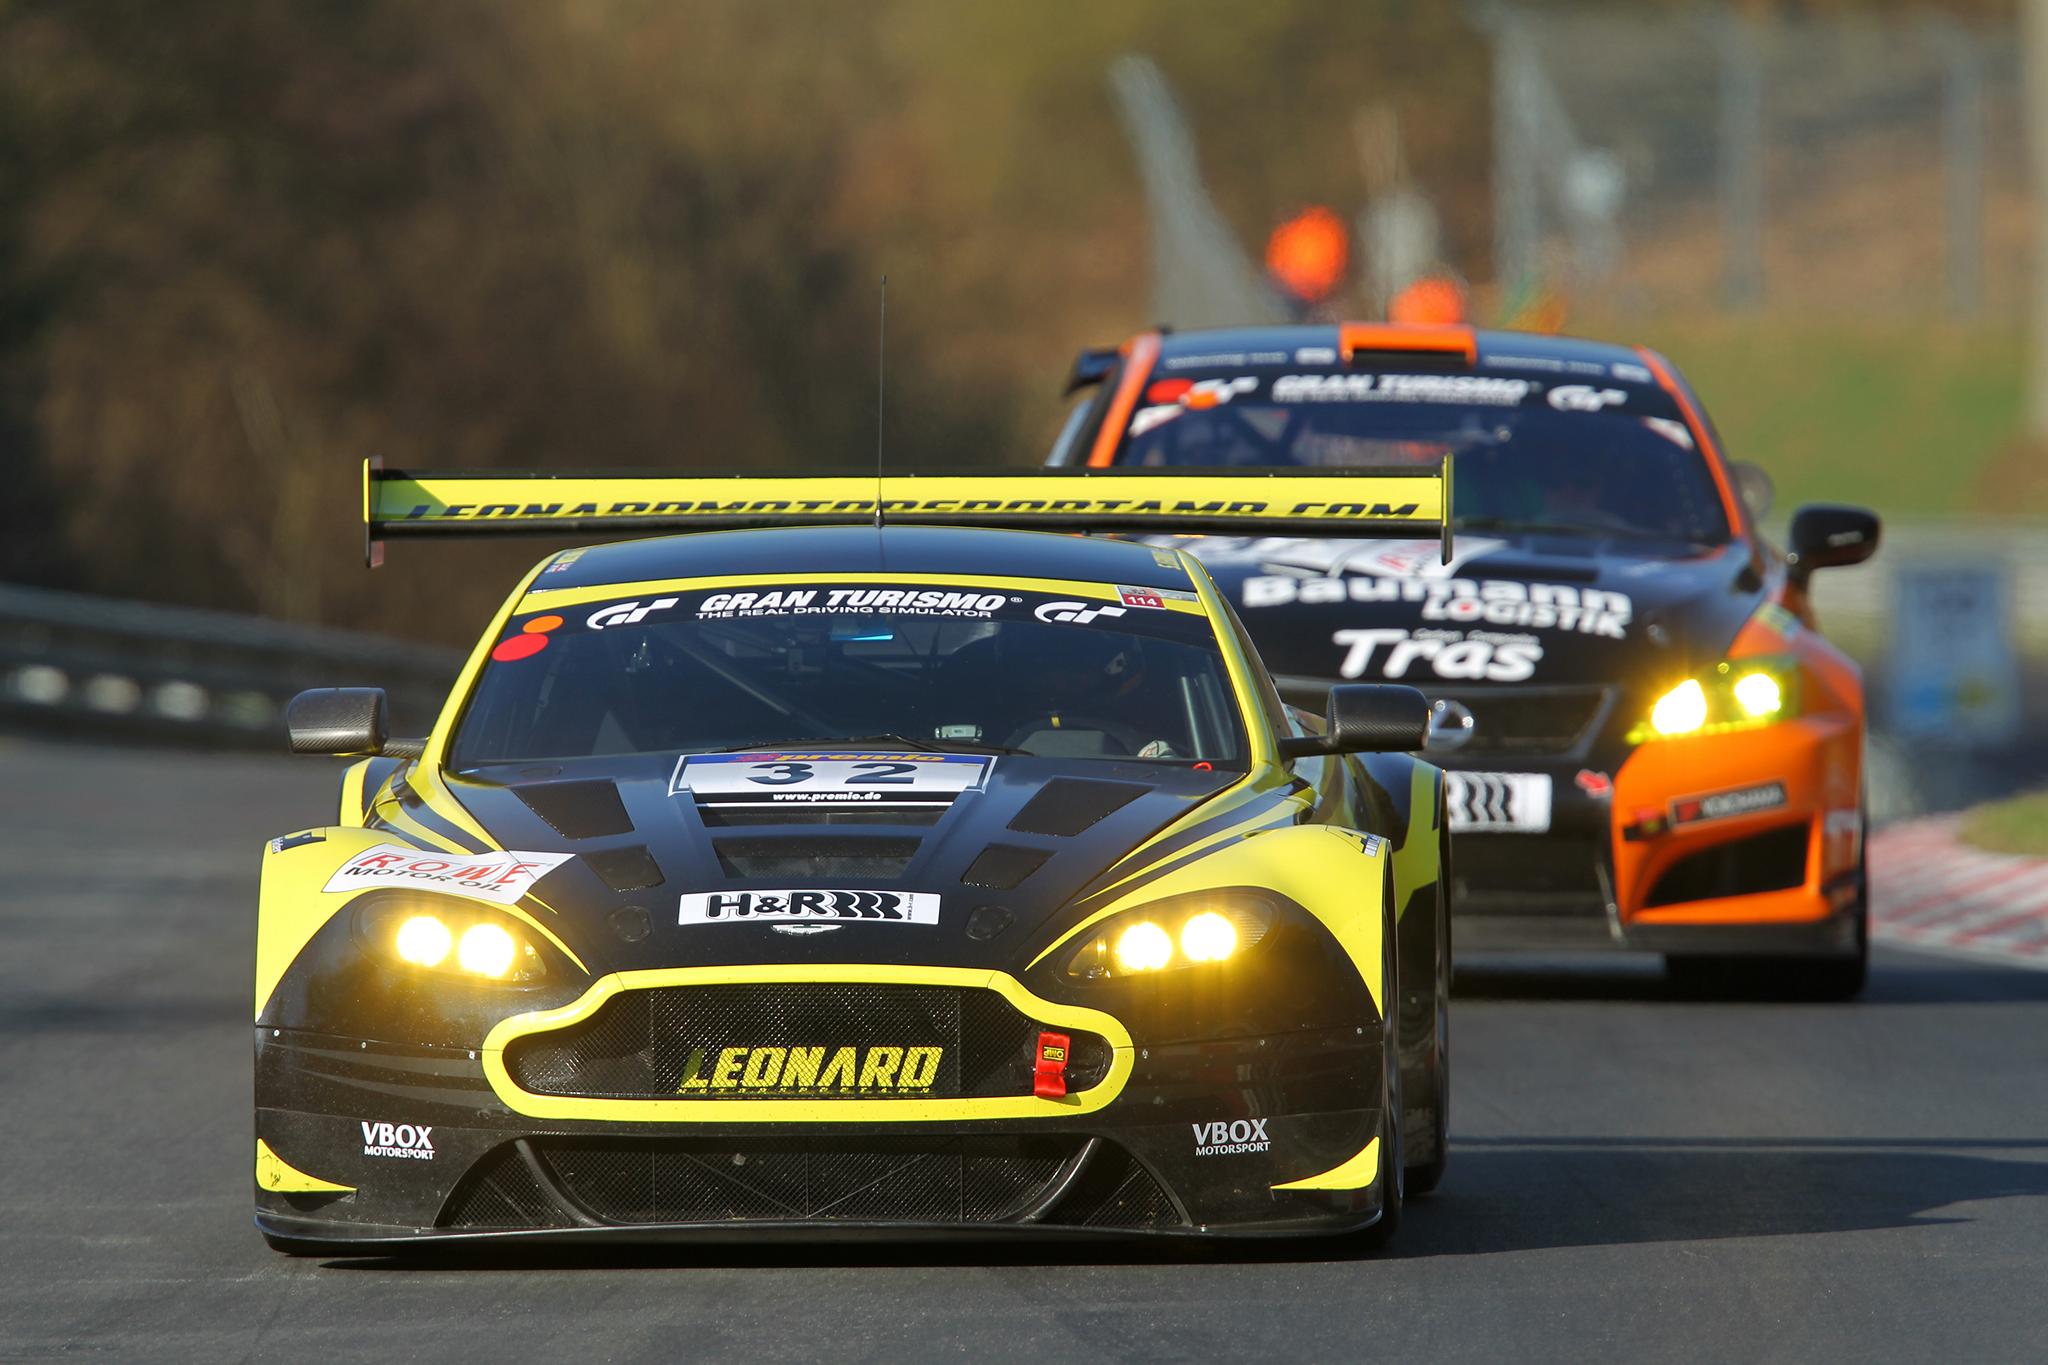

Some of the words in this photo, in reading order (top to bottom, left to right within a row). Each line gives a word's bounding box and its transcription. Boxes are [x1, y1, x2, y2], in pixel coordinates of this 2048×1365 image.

[700, 590, 818, 612] GRAN
[821, 589, 1007, 612] TURISMO
[1127, 595, 1158, 607] 114
[1242, 574, 1632, 620] Baumann
[696, 611, 734, 620] THE
[738, 608, 788, 618] REAL
[793, 606, 874, 615] DRIVING
[878, 605, 992, 619] SIMULATOR
[1421, 599, 1626, 640] LOGISTIK
[1332, 628, 1545, 682] Tras
[344, 866, 454, 882] MOTOR
[458, 879, 503, 893] OIL
[359, 854, 539, 885] ROWE
[681, 1046, 945, 1088] LEONARD
[361, 1121, 434, 1149] VBOX
[1191, 1118, 1269, 1146] VBOX
[364, 1145, 436, 1160] MOTORSPORT
[1195, 1141, 1271, 1157] MOTORSPORT
